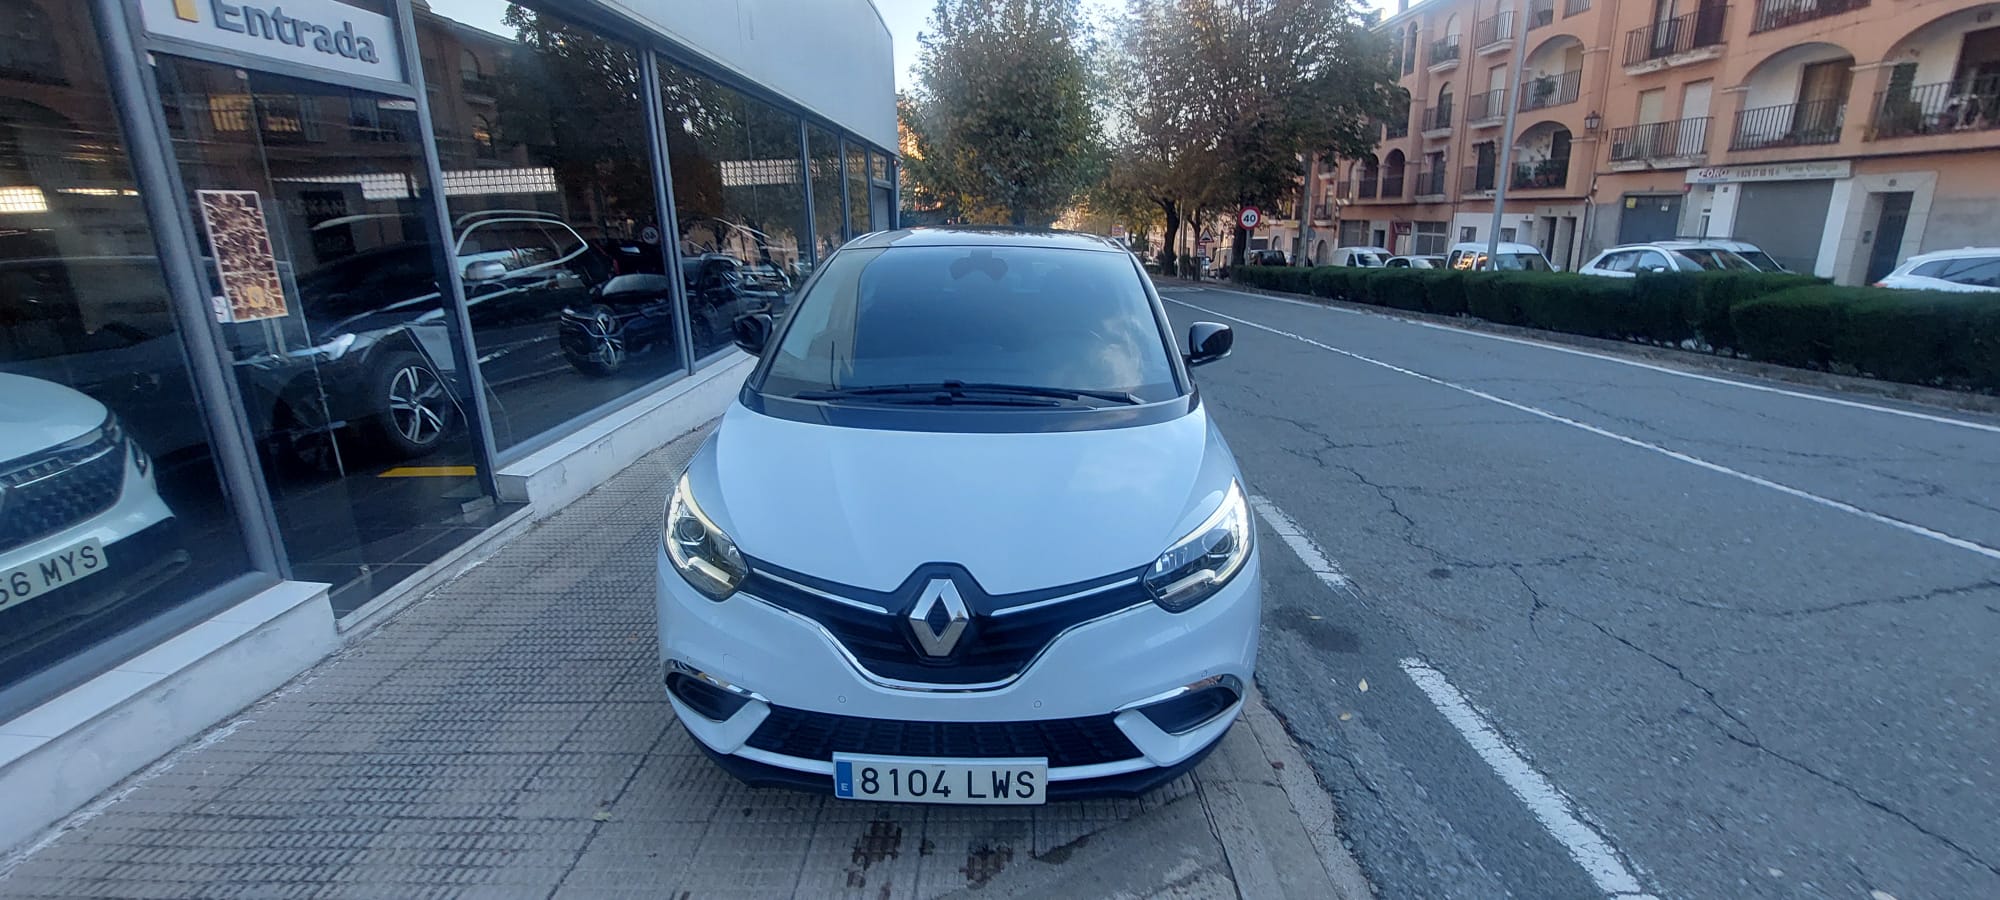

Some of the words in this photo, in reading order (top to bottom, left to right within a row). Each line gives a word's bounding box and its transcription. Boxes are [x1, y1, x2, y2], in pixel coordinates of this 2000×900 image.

[210, 0, 380, 64] Entrada
[1243, 214, 1256, 222] 40
[39, 546, 98, 587] MYS
[861, 767, 951, 798] 8104
[967, 770, 1035, 799] LWS
